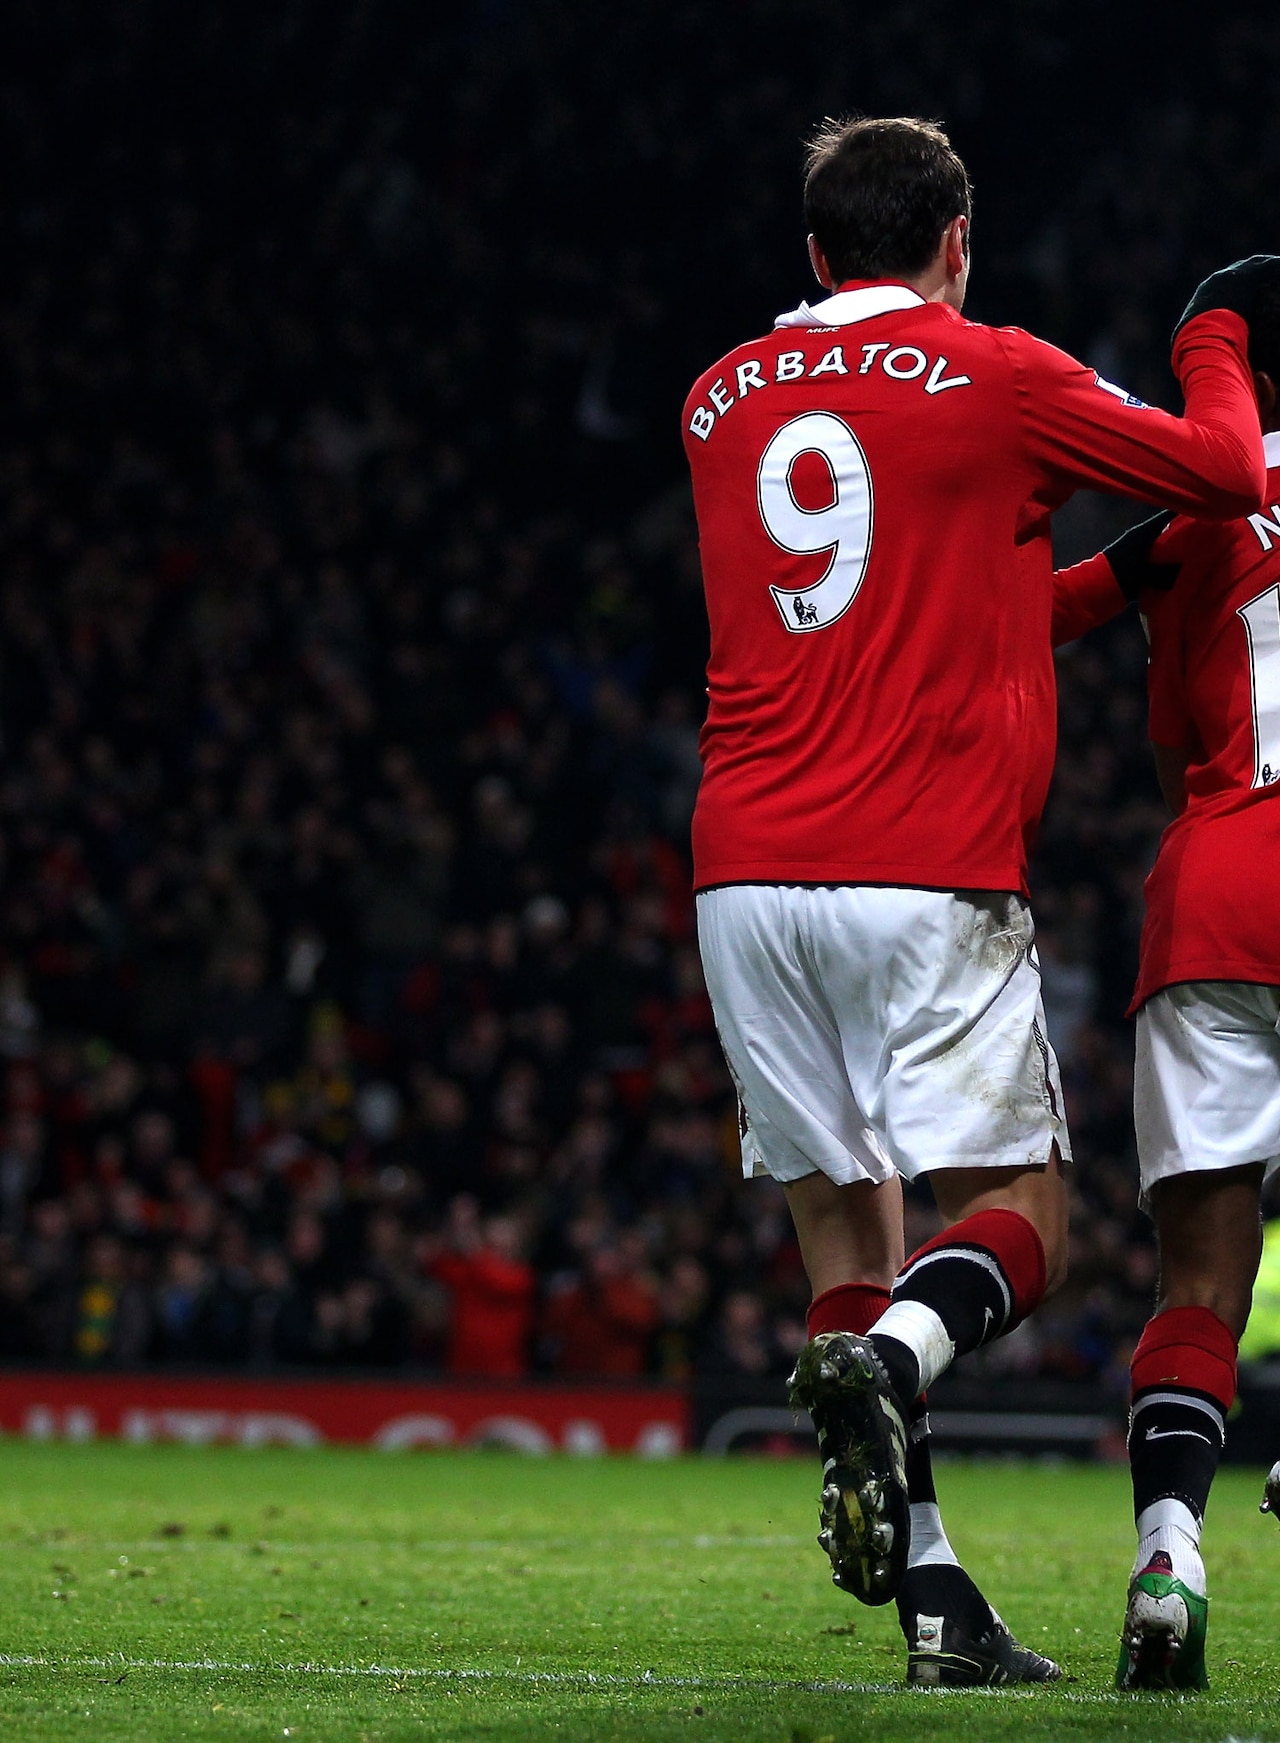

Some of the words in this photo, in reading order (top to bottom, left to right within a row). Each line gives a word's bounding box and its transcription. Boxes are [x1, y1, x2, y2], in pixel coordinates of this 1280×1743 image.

[806, 326, 841, 334] MUFC
[689, 342, 972, 442] BERBATOV
[756, 409, 875, 635] 9
